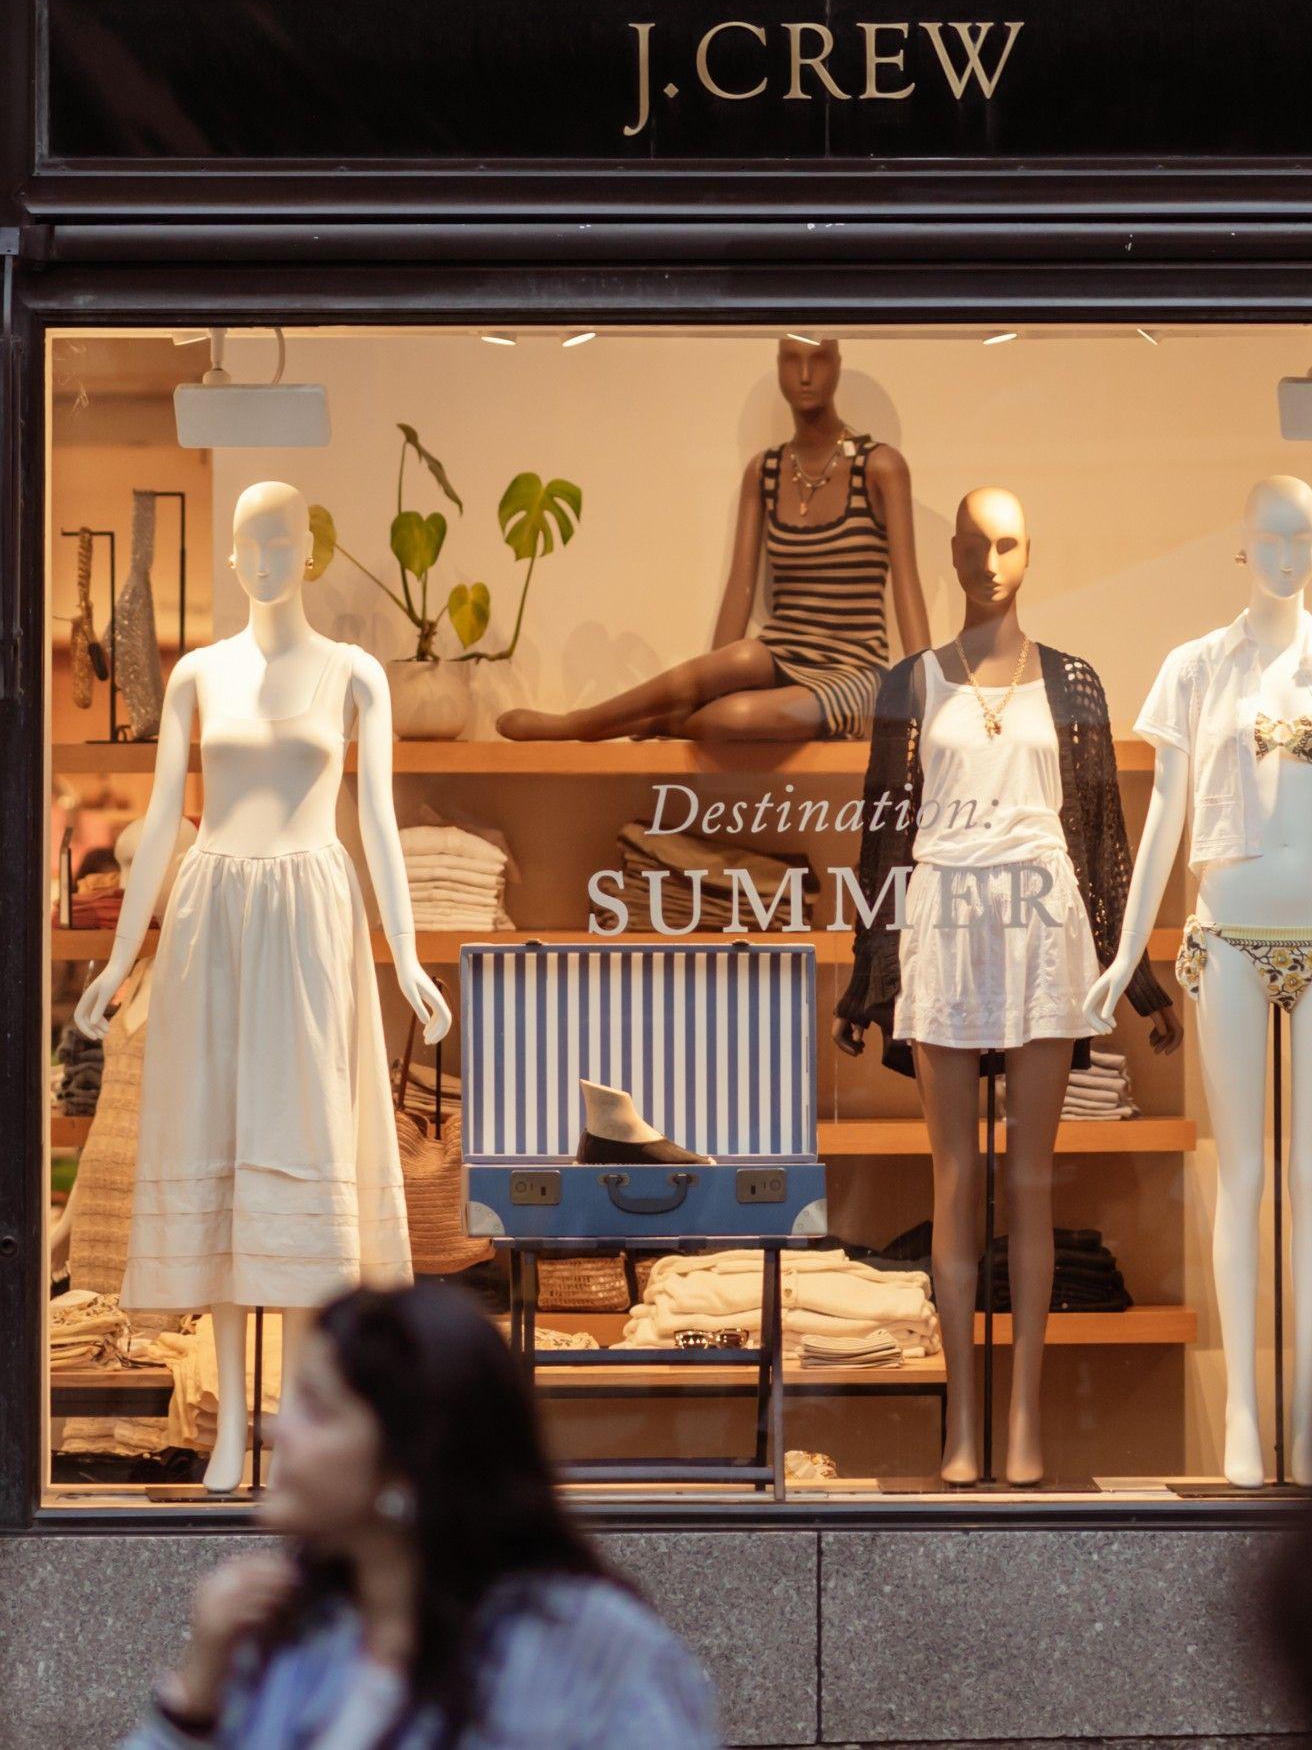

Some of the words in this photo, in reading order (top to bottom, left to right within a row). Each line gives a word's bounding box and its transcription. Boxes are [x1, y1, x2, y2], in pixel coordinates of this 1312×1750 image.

[623, 21, 1025, 136] J.CREW
[643, 783, 1000, 837] Destination:
[587, 862, 1064, 937] SUMMER
